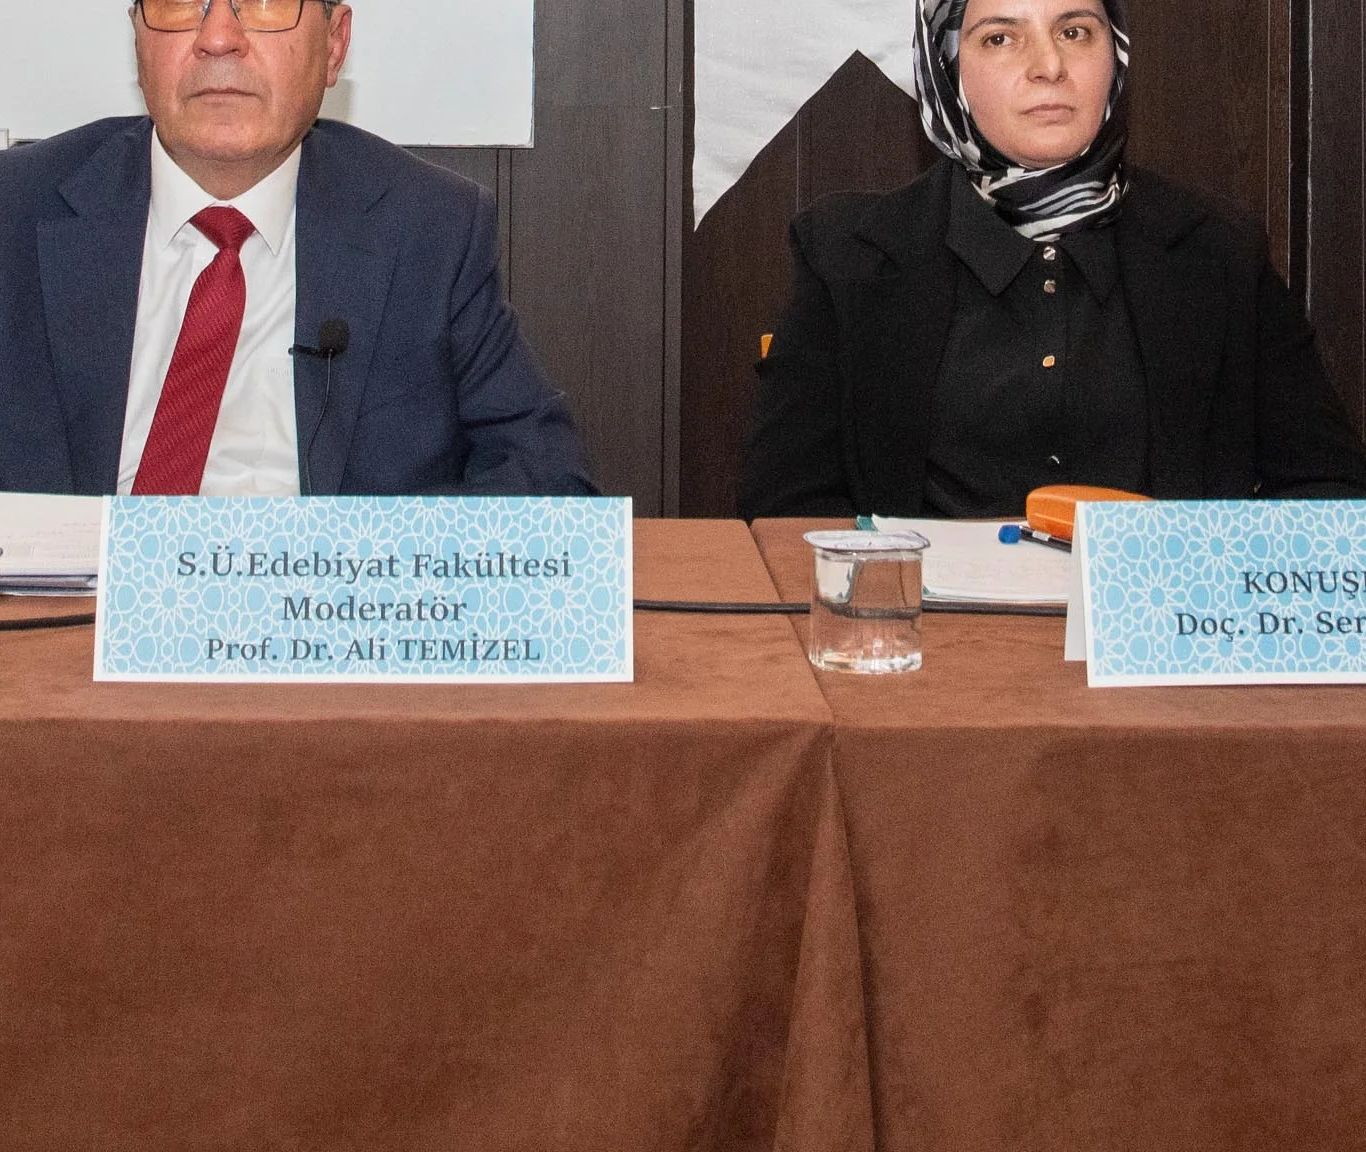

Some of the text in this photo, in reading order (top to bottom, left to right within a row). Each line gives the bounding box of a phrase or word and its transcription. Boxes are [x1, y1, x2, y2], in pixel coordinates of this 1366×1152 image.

[411, 551, 572, 579] Fakültesi
[281, 595, 467, 622] Moderatör
[1176, 612, 1244, 643] Doç.
[1257, 613, 1304, 635] Dr.
[206, 632, 542, 661] Prof. Dr. Ali TEMİZEL
